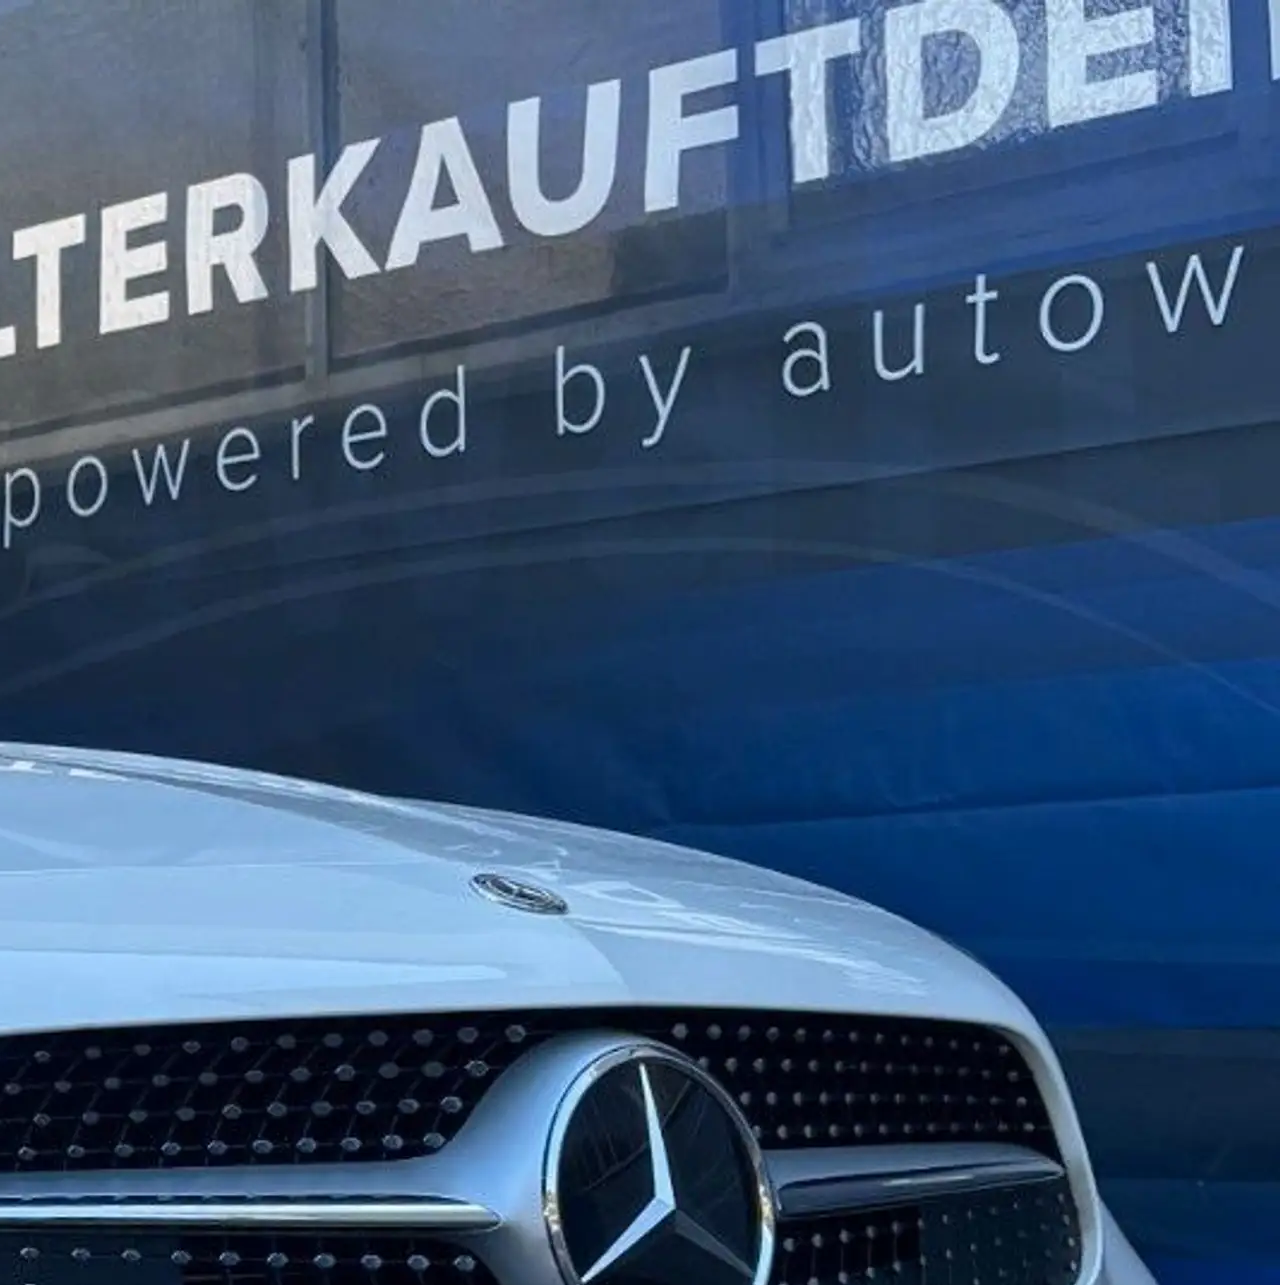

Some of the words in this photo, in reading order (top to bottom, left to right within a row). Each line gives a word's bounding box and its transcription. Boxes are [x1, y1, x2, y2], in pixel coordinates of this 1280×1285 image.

[3, 364, 467, 548] powered
[555, 345, 692, 447] by
[781, 245, 1244, 397] autow
